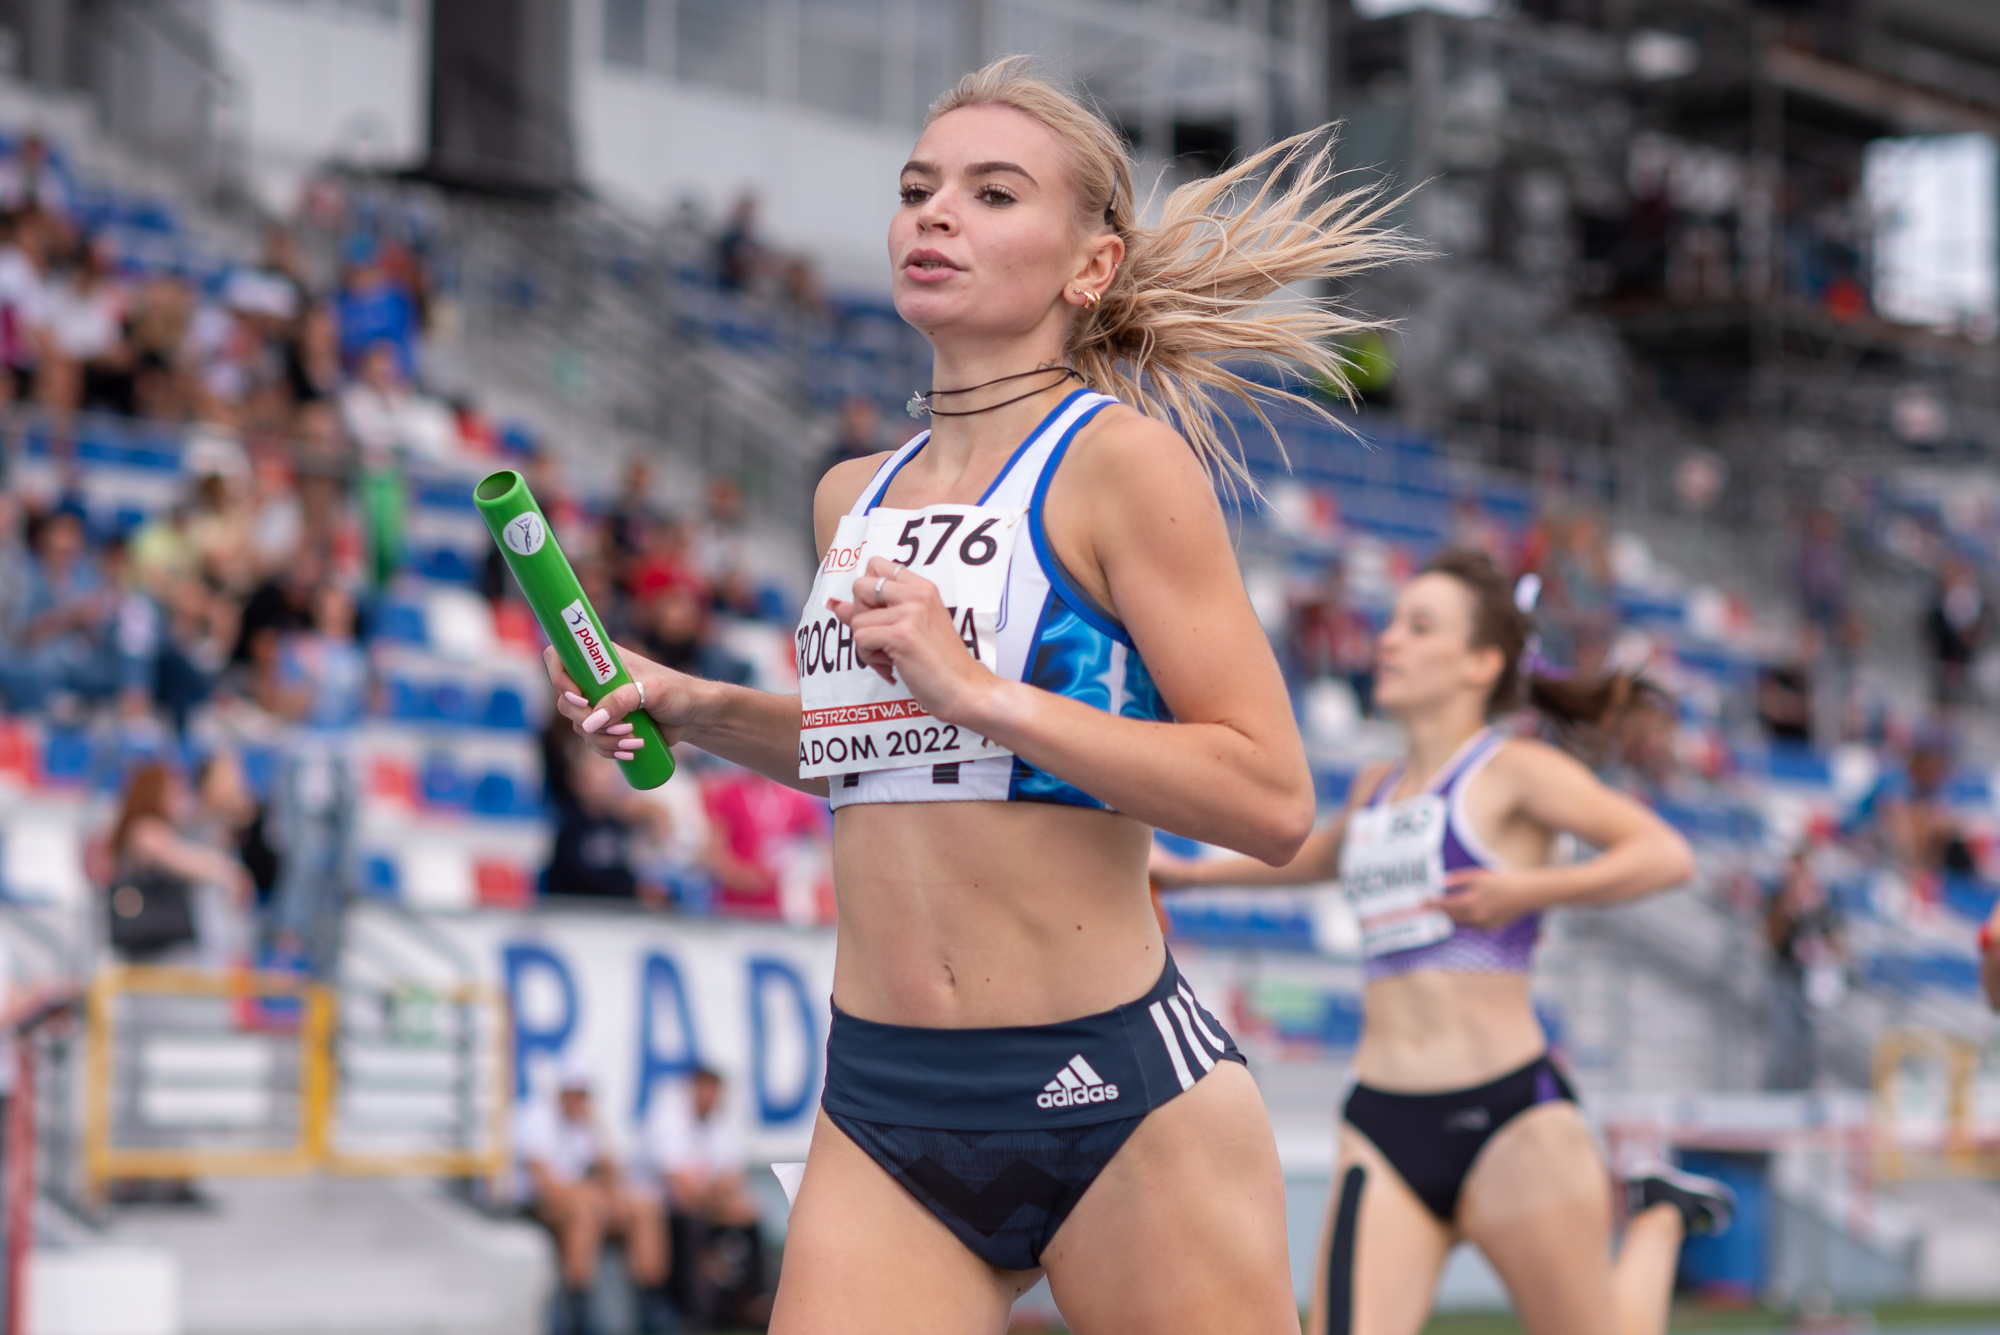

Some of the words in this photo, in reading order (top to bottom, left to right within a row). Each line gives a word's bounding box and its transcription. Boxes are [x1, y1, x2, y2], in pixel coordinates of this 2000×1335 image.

[892, 514, 1001, 567] 576
[574, 627, 611, 677] polanik
[802, 703, 906, 727] MISTRZOSTWA
[886, 725, 961, 758] 2022
[1036, 1083, 1119, 1109] adidas
